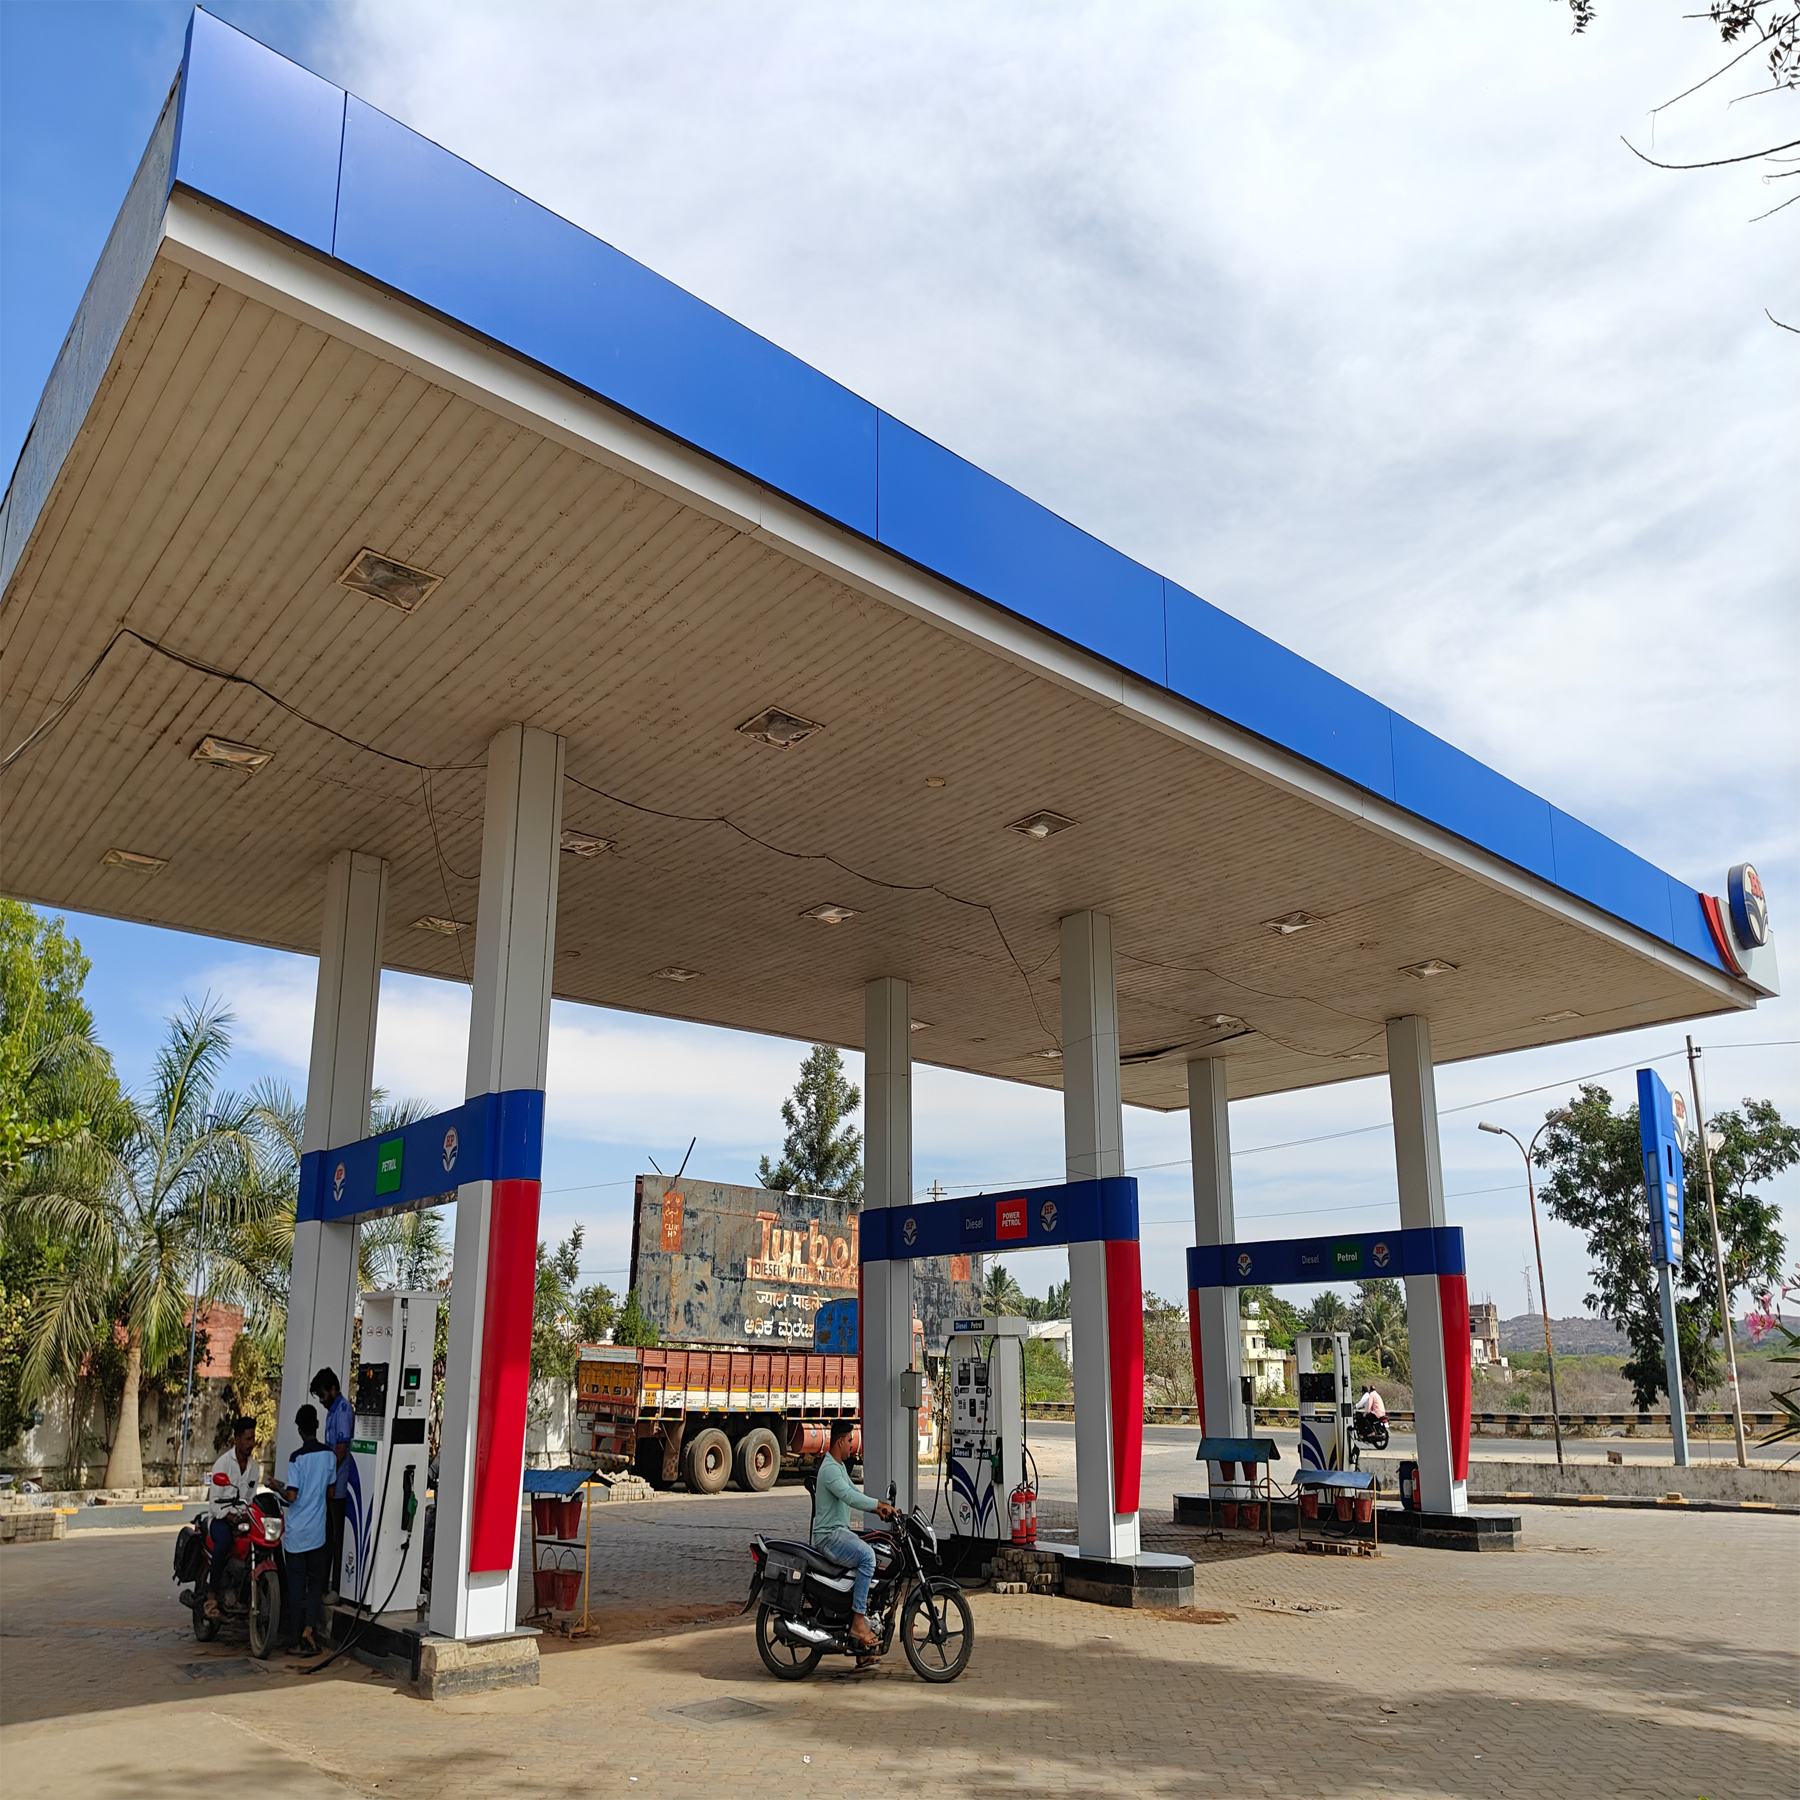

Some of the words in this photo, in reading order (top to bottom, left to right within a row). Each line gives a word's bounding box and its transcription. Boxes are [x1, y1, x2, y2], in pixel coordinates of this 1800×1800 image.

[381, 1158, 397, 1173] PETROL
[1044, 1204, 1055, 1215] HP
[1002, 1211, 1021, 1221] POWER
[965, 1217, 984, 1230] Diesel
[1002, 1218, 1022, 1228] PETROL
[1301, 1254, 1320, 1265] Diesel
[1337, 1251, 1358, 1263] Petrol
[755, 1262, 781, 1277] DIESEL
[787, 1265, 809, 1280] WITH
[955, 1321, 968, 1330] Diesel
[970, 1320, 983, 1330] Petrol
[410, 1341, 417, 1353] 5
[591, 1384, 622, 1396] DAS
[954, 1448, 970, 1458] Diesel
